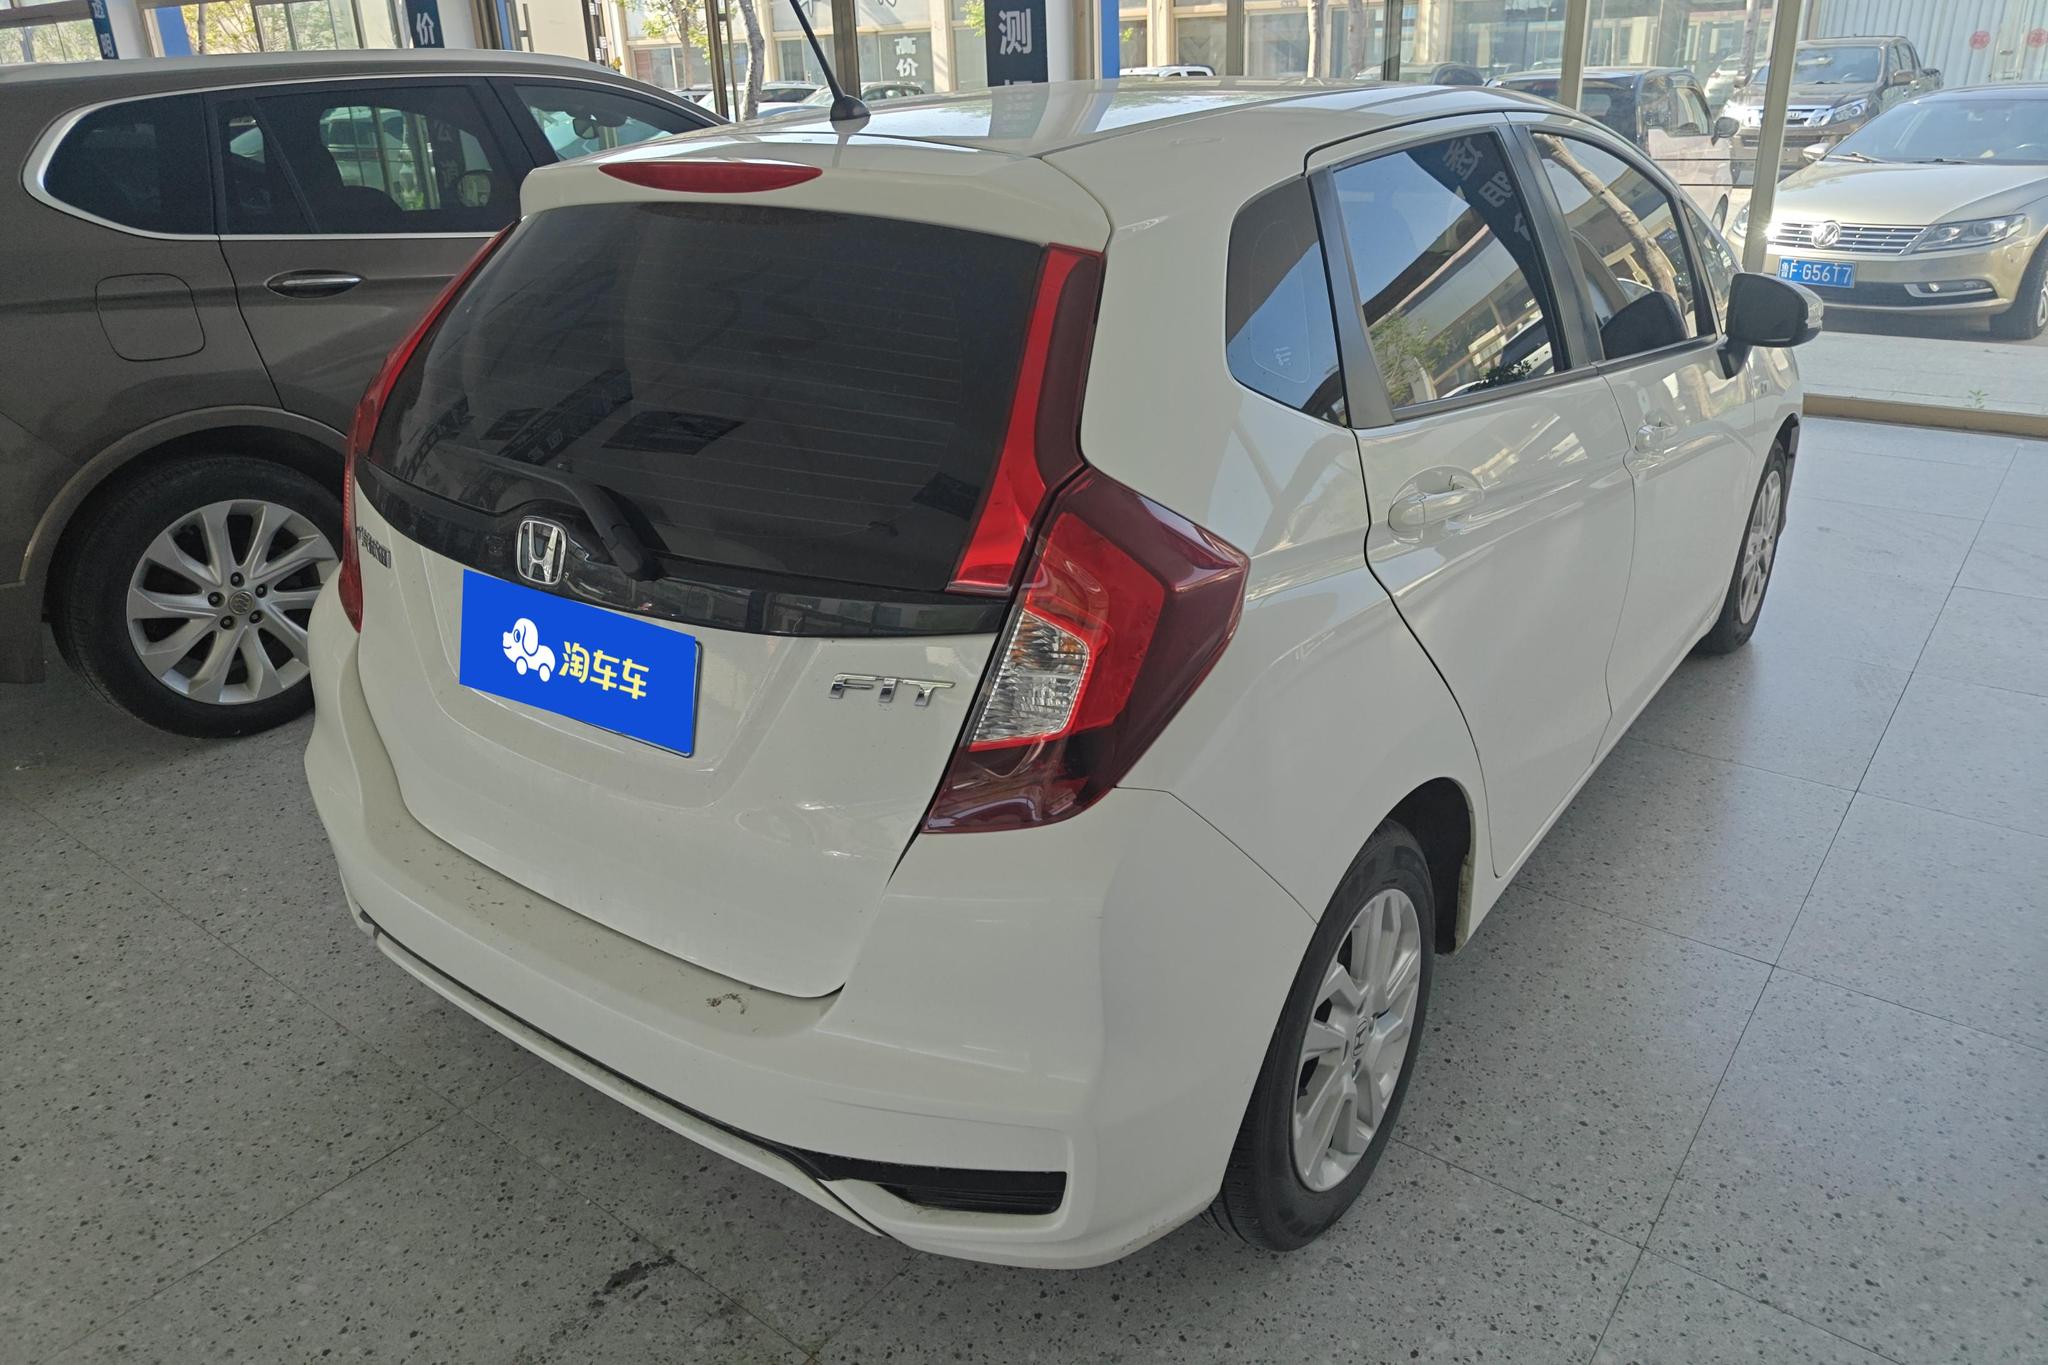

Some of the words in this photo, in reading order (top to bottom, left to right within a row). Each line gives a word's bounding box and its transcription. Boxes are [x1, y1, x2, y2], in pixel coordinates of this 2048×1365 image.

[416, 12, 434, 45] 价
[998, 8, 1033, 86] 测
[894, 36, 919, 77] 高价
[828, 672, 956, 707] FIT
